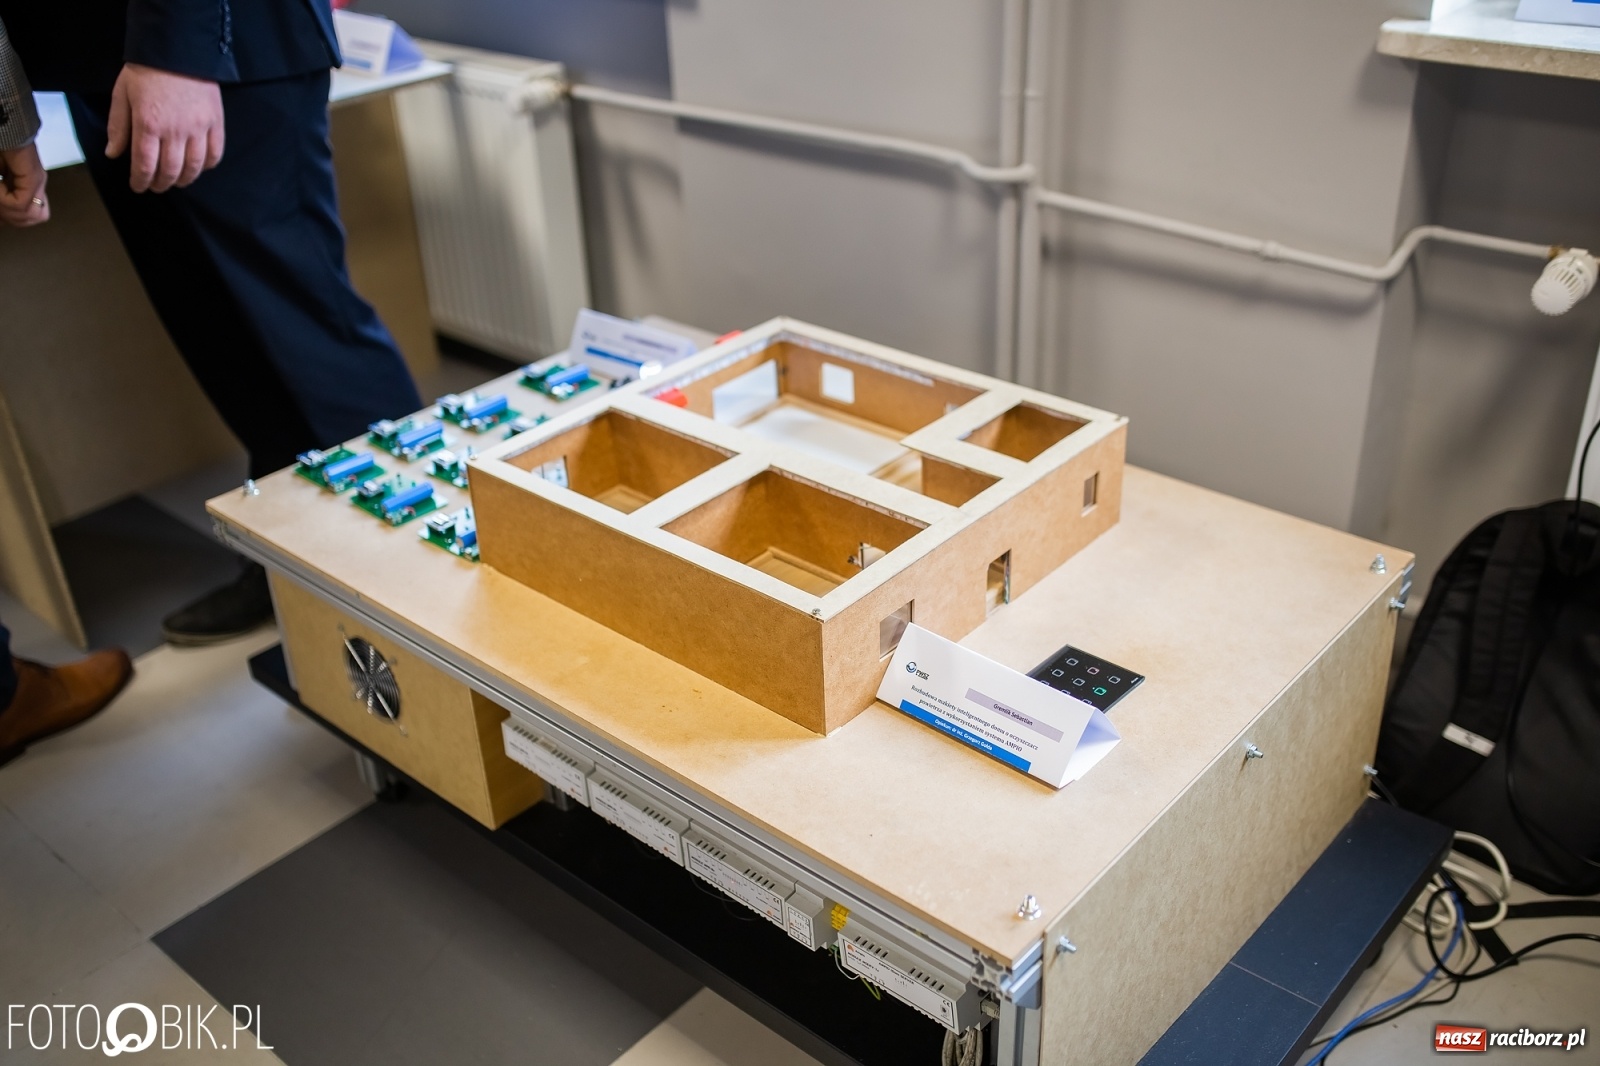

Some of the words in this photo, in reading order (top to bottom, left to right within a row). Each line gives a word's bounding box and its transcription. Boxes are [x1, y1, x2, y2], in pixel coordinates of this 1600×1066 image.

[937, 699, 957, 711] makiety
[1011, 711, 1033, 726] Sebastian
[918, 699, 942, 713] powietrza
[946, 711, 985, 733] wykorzystaniem
[1005, 740, 1023, 752] AMPIO
[963, 733, 981, 745] Grzegorz
